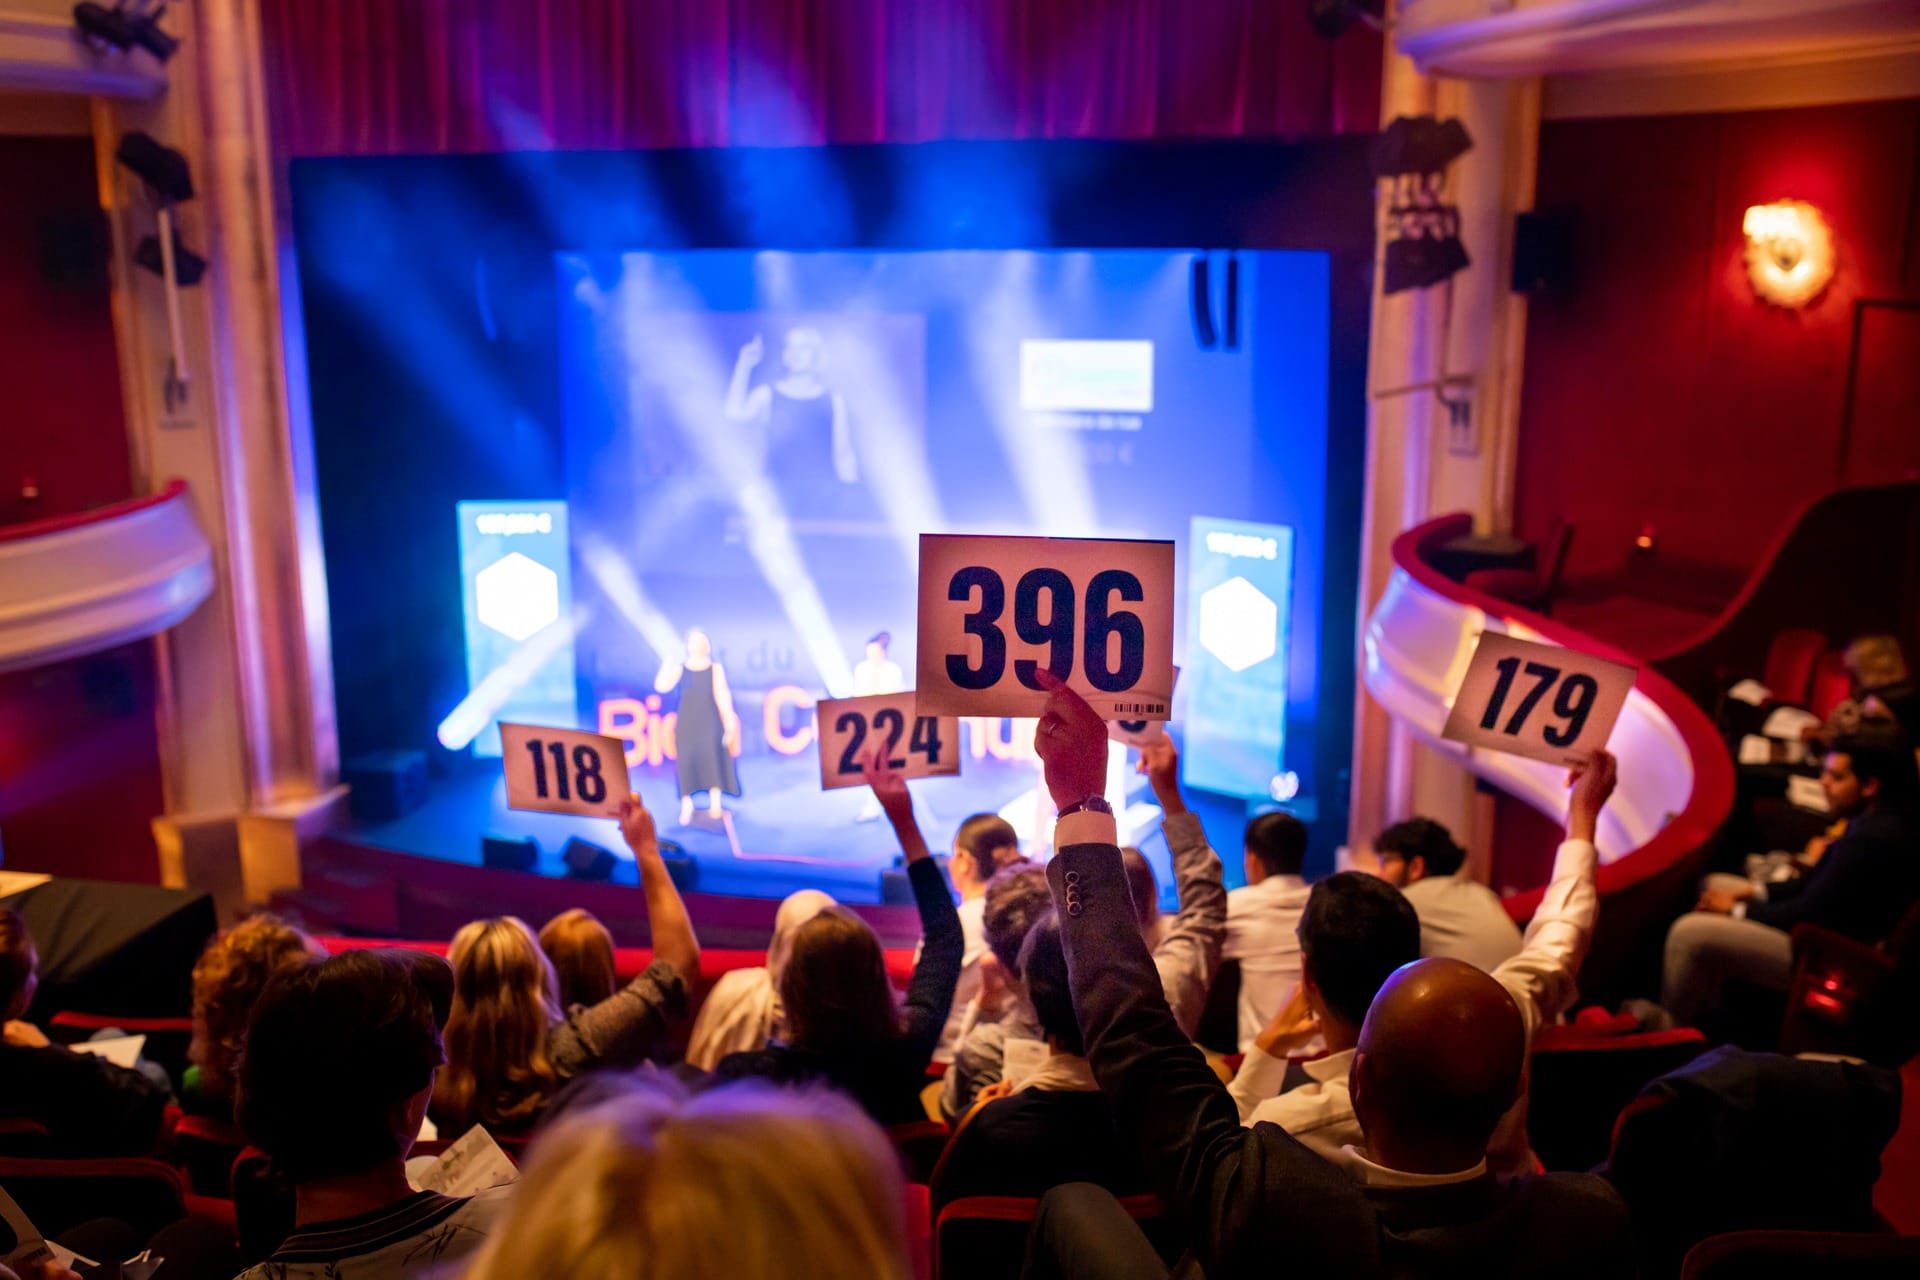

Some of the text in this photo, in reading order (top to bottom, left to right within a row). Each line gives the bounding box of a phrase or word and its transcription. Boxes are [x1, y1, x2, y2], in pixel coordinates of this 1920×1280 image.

[945, 566, 1144, 692] 396
[835, 708, 942, 775] 224
[1480, 656, 1598, 748] 179
[526, 738, 607, 805] 118
